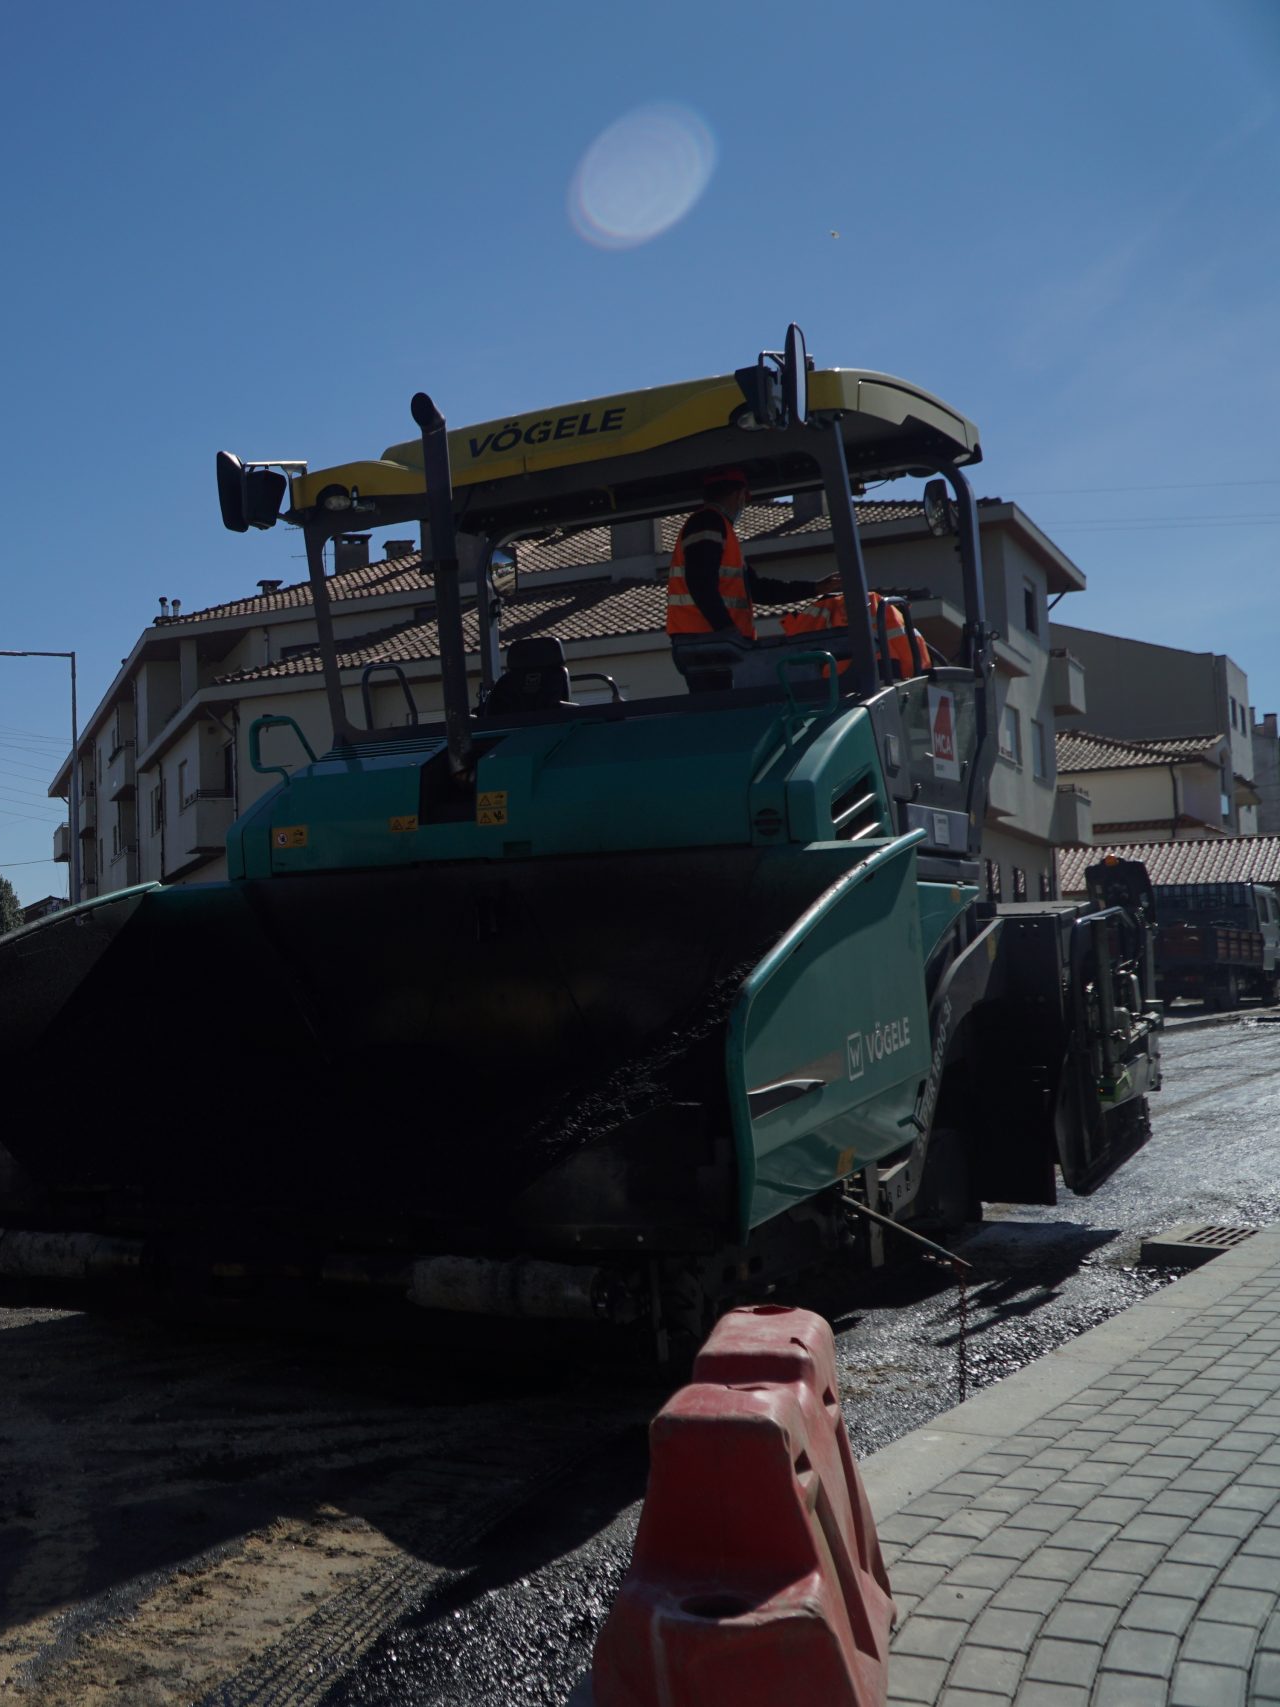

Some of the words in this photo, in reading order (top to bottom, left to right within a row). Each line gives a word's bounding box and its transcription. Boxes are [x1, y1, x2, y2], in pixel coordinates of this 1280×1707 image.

[469, 407, 626, 457] VÖGELE
[934, 732, 953, 756] MCA
[865, 1016, 911, 1063] VÖGELE
